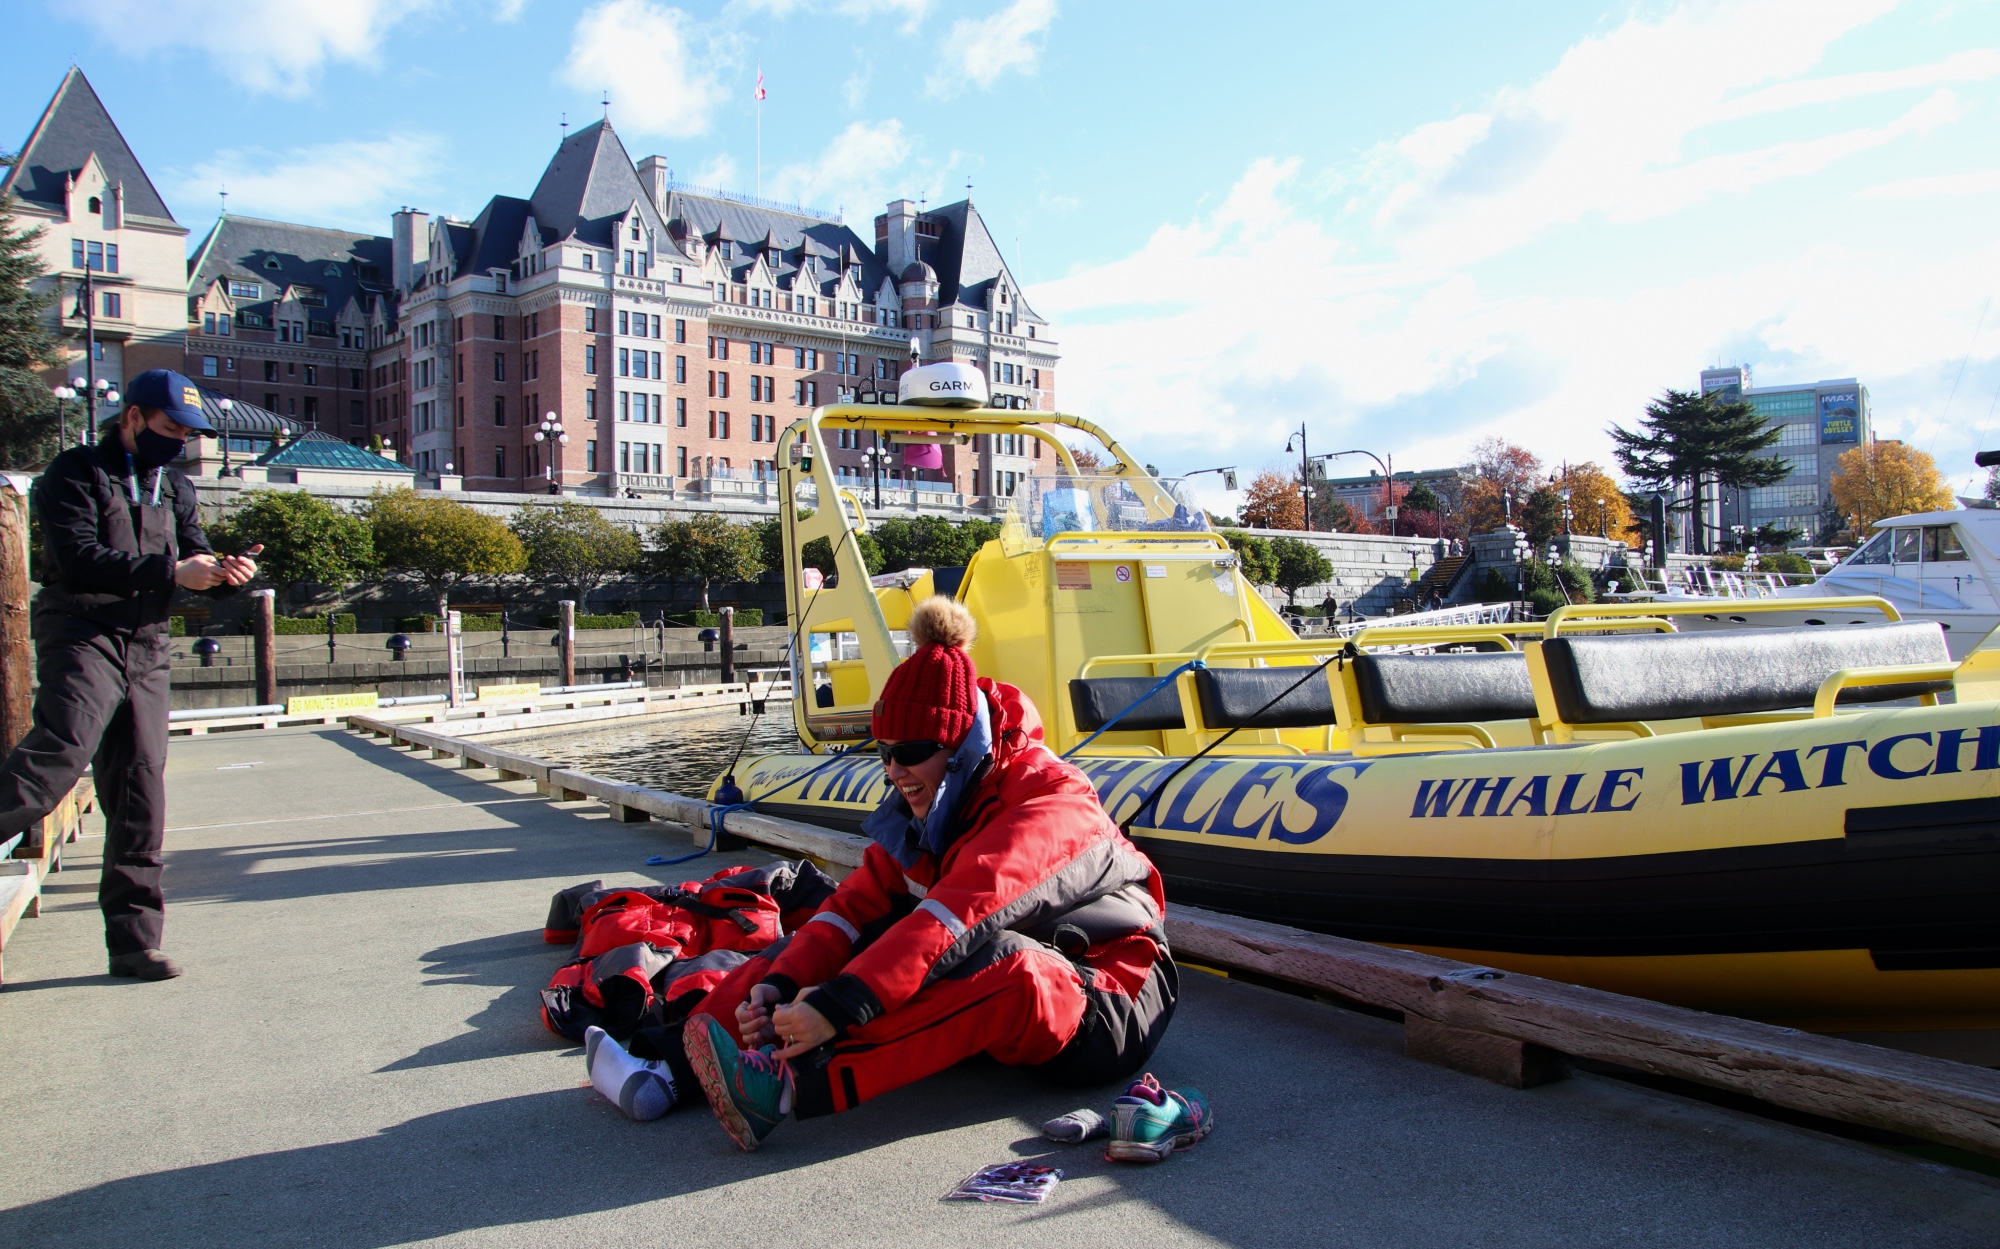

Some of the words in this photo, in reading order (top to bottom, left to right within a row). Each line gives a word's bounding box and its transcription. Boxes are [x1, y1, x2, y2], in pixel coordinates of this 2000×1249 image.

[1821, 394, 1854, 403] IMAX
[1823, 426, 1854, 434] ODYSSEY
[1826, 420, 1851, 428] TURTLE
[291, 700, 302, 712] 30
[303, 698, 335, 711] MINUTE
[337, 695, 376, 709] MAXIMUM
[749, 770, 771, 788] The
[1409, 767, 1644, 819] WHALE
